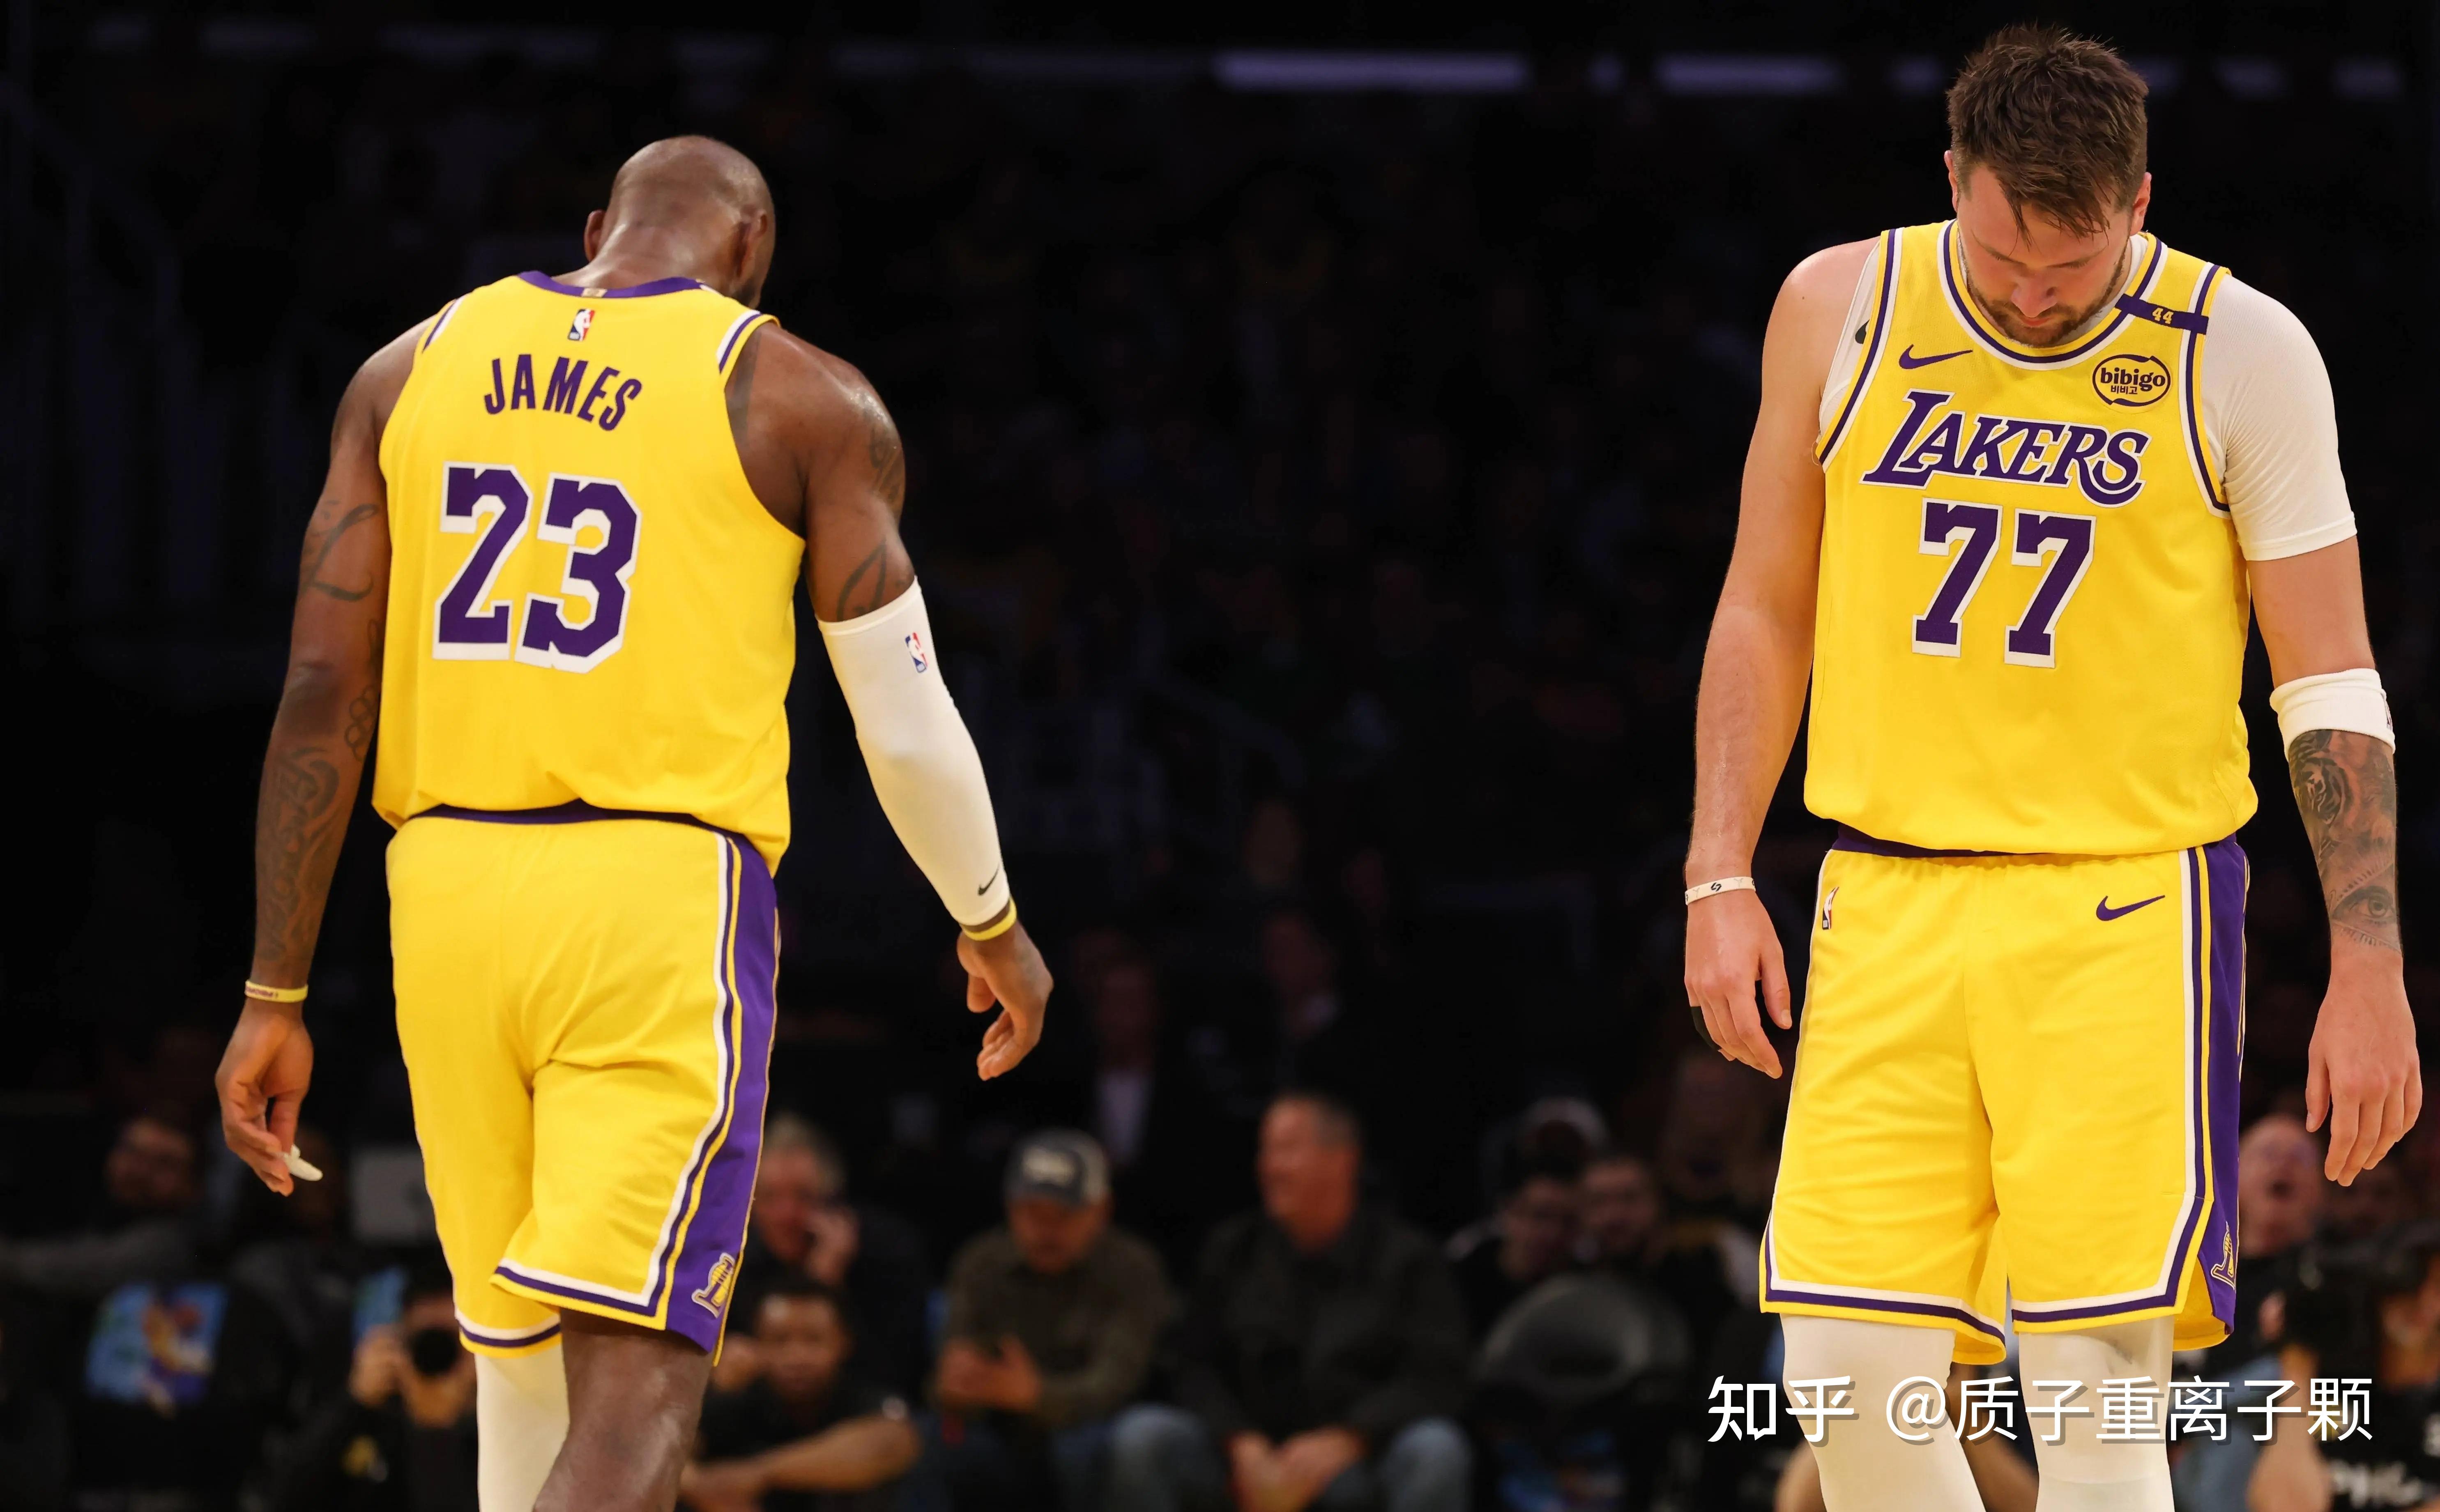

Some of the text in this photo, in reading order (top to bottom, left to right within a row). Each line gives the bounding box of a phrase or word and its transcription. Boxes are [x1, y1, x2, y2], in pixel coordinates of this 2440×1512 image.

[2152, 308, 2174, 324] 44
[484, 354, 642, 431] JAMES
[2100, 367, 2166, 391] bibigo
[2111, 385, 2138, 394] 비비고
[1859, 388, 2152, 508] LAKERS
[432, 461, 642, 674] 23
[1912, 498, 2096, 667] 77
